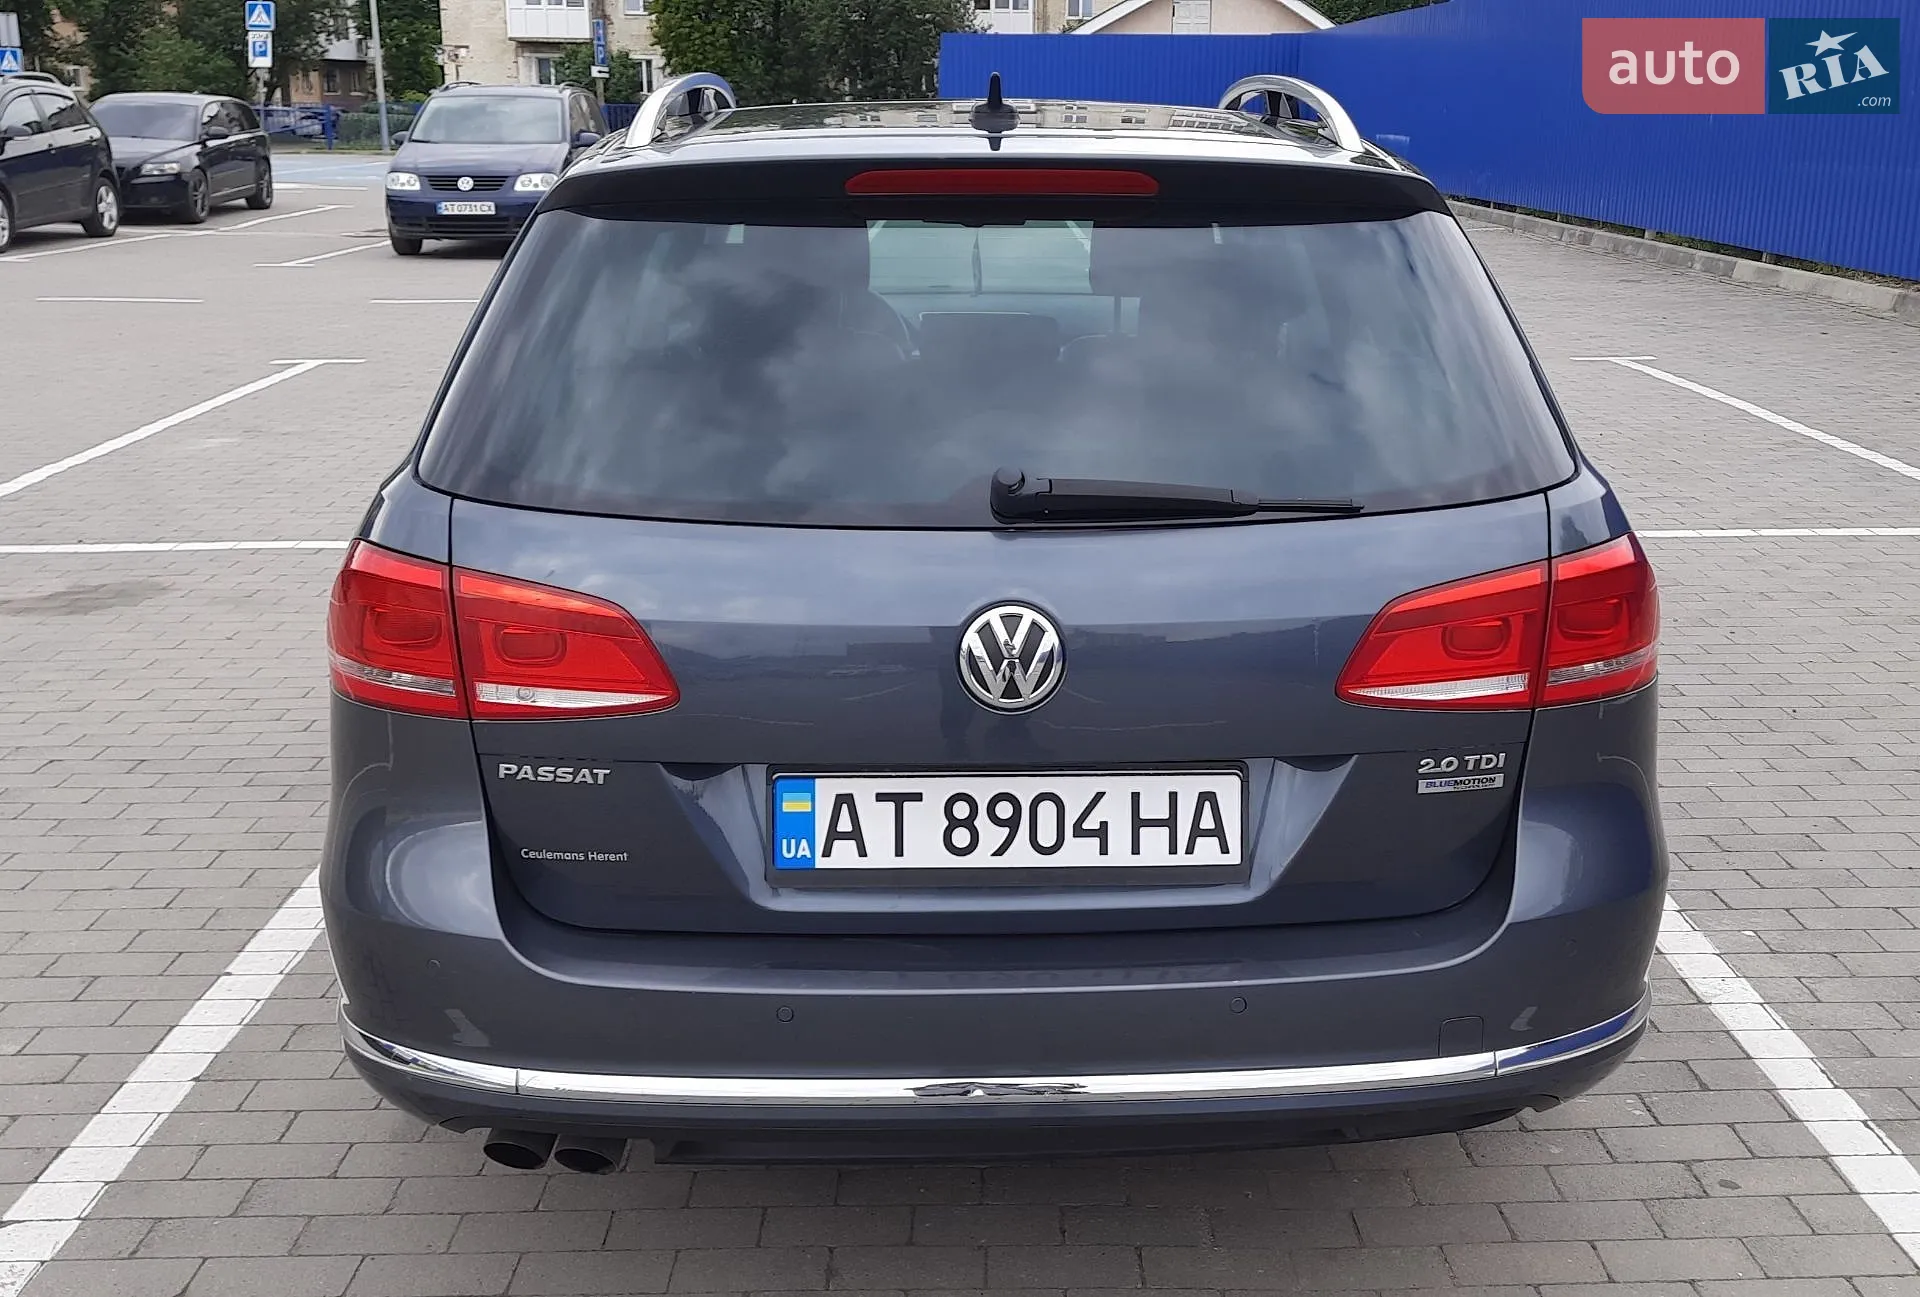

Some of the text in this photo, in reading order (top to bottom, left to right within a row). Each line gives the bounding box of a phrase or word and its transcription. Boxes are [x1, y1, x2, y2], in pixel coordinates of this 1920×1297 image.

[444, 204, 455, 212] AT
[1464, 753, 1506, 770] TDI
[498, 763, 611, 785] PASSAT
[1425, 776, 1496, 788] BLUEMOTION
[821, 791, 1230, 857] AT 8904 HA
[521, 848, 628, 861] Ceulemans Herent
[782, 838, 812, 858] UA
